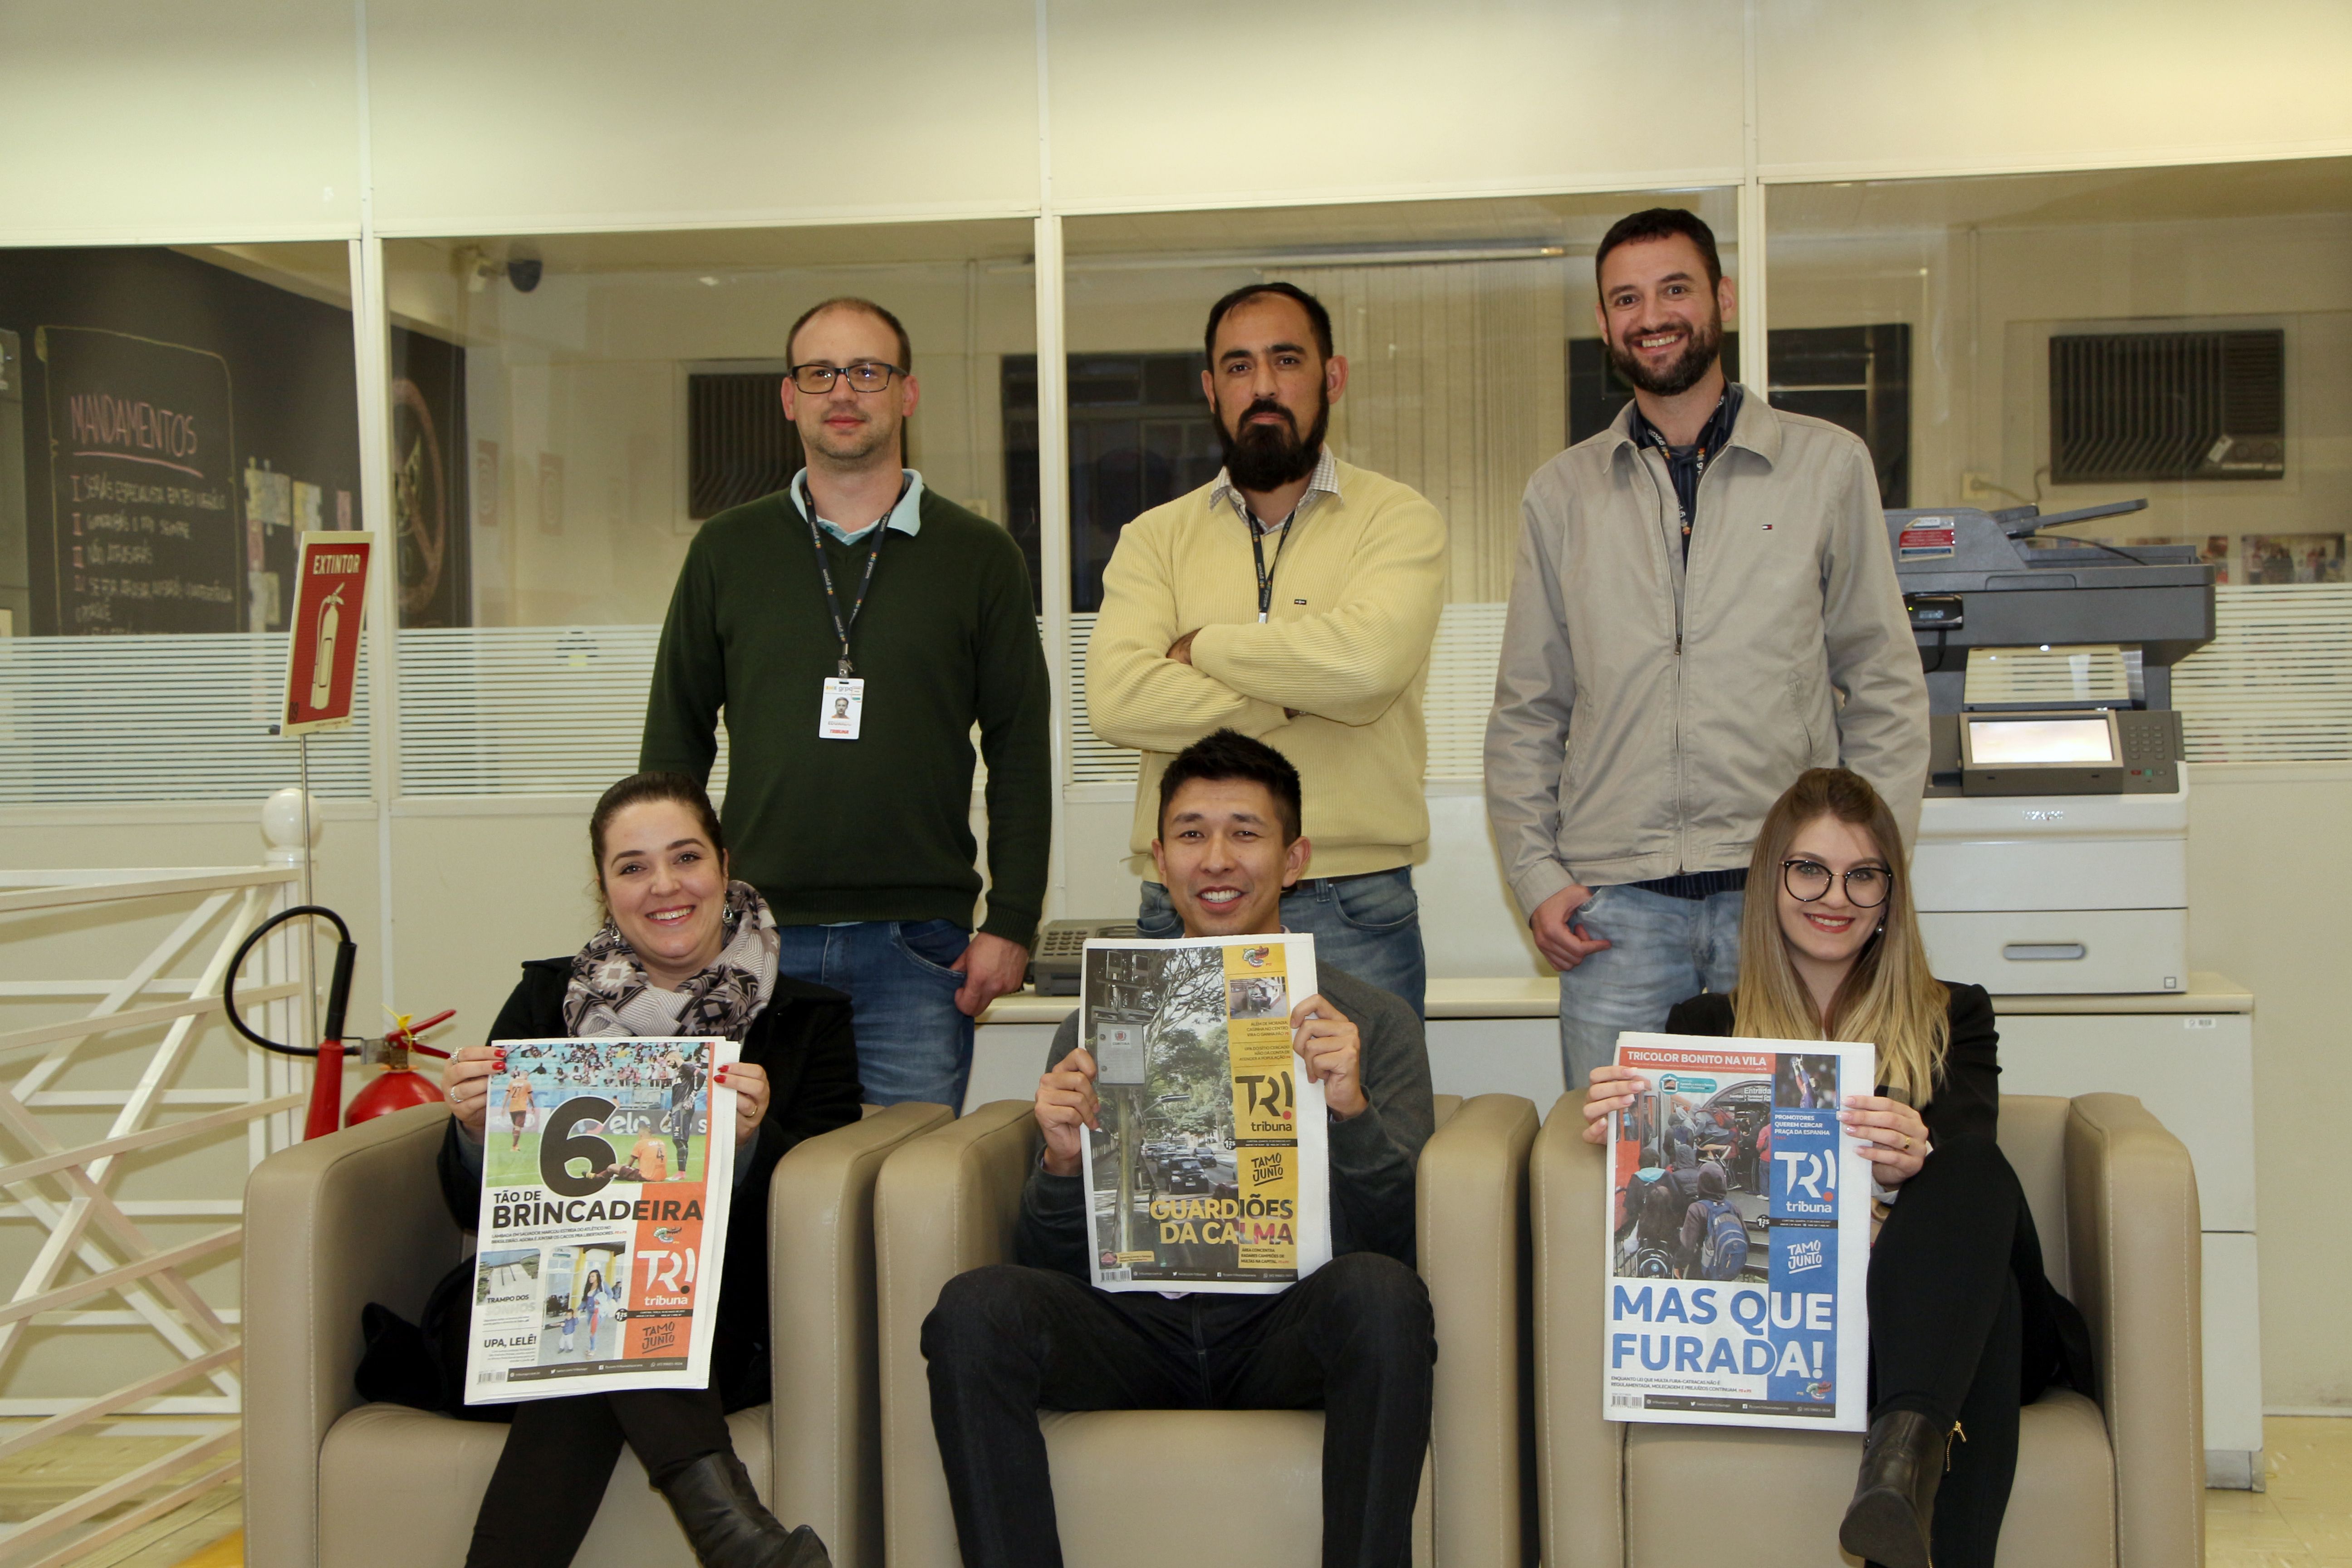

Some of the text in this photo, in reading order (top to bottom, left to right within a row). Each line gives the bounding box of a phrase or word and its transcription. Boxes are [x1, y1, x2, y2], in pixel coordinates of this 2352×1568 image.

[71, 394, 197, 457] MANDAMENTOS
[313, 554, 361, 574] EXTINTOR
[1627, 1051, 1679, 1062] TRICOLOR
[1681, 1054, 1723, 1064] BONITO
[1725, 1056, 1741, 1064] NA
[1742, 1056, 1766, 1066] VILA
[1251, 1121, 1292, 1132] tribuna
[539, 1095, 619, 1197] 6
[1251, 1153, 1282, 1168] TAMO
[1253, 1164, 1283, 1181] JUNTO
[494, 1191, 542, 1204] TÃO DE
[492, 1200, 703, 1228] BRINCADEIRA
[1150, 1194, 1293, 1220] GUARDIÕES
[1786, 1200, 1832, 1213] tribuna
[1160, 1222, 1294, 1245] DA CALMA
[1787, 1240, 1821, 1255] TAMO
[1788, 1252, 1822, 1269] JUNTO
[645, 1295, 688, 1306] tribuna
[1613, 1285, 1832, 1335] MAS QUE
[642, 1321, 675, 1337] TAMO
[484, 1334, 537, 1348] UPA, LELÊ!
[642, 1332, 675, 1349] JUNTO
[1612, 1333, 1823, 1379] FURADA!
